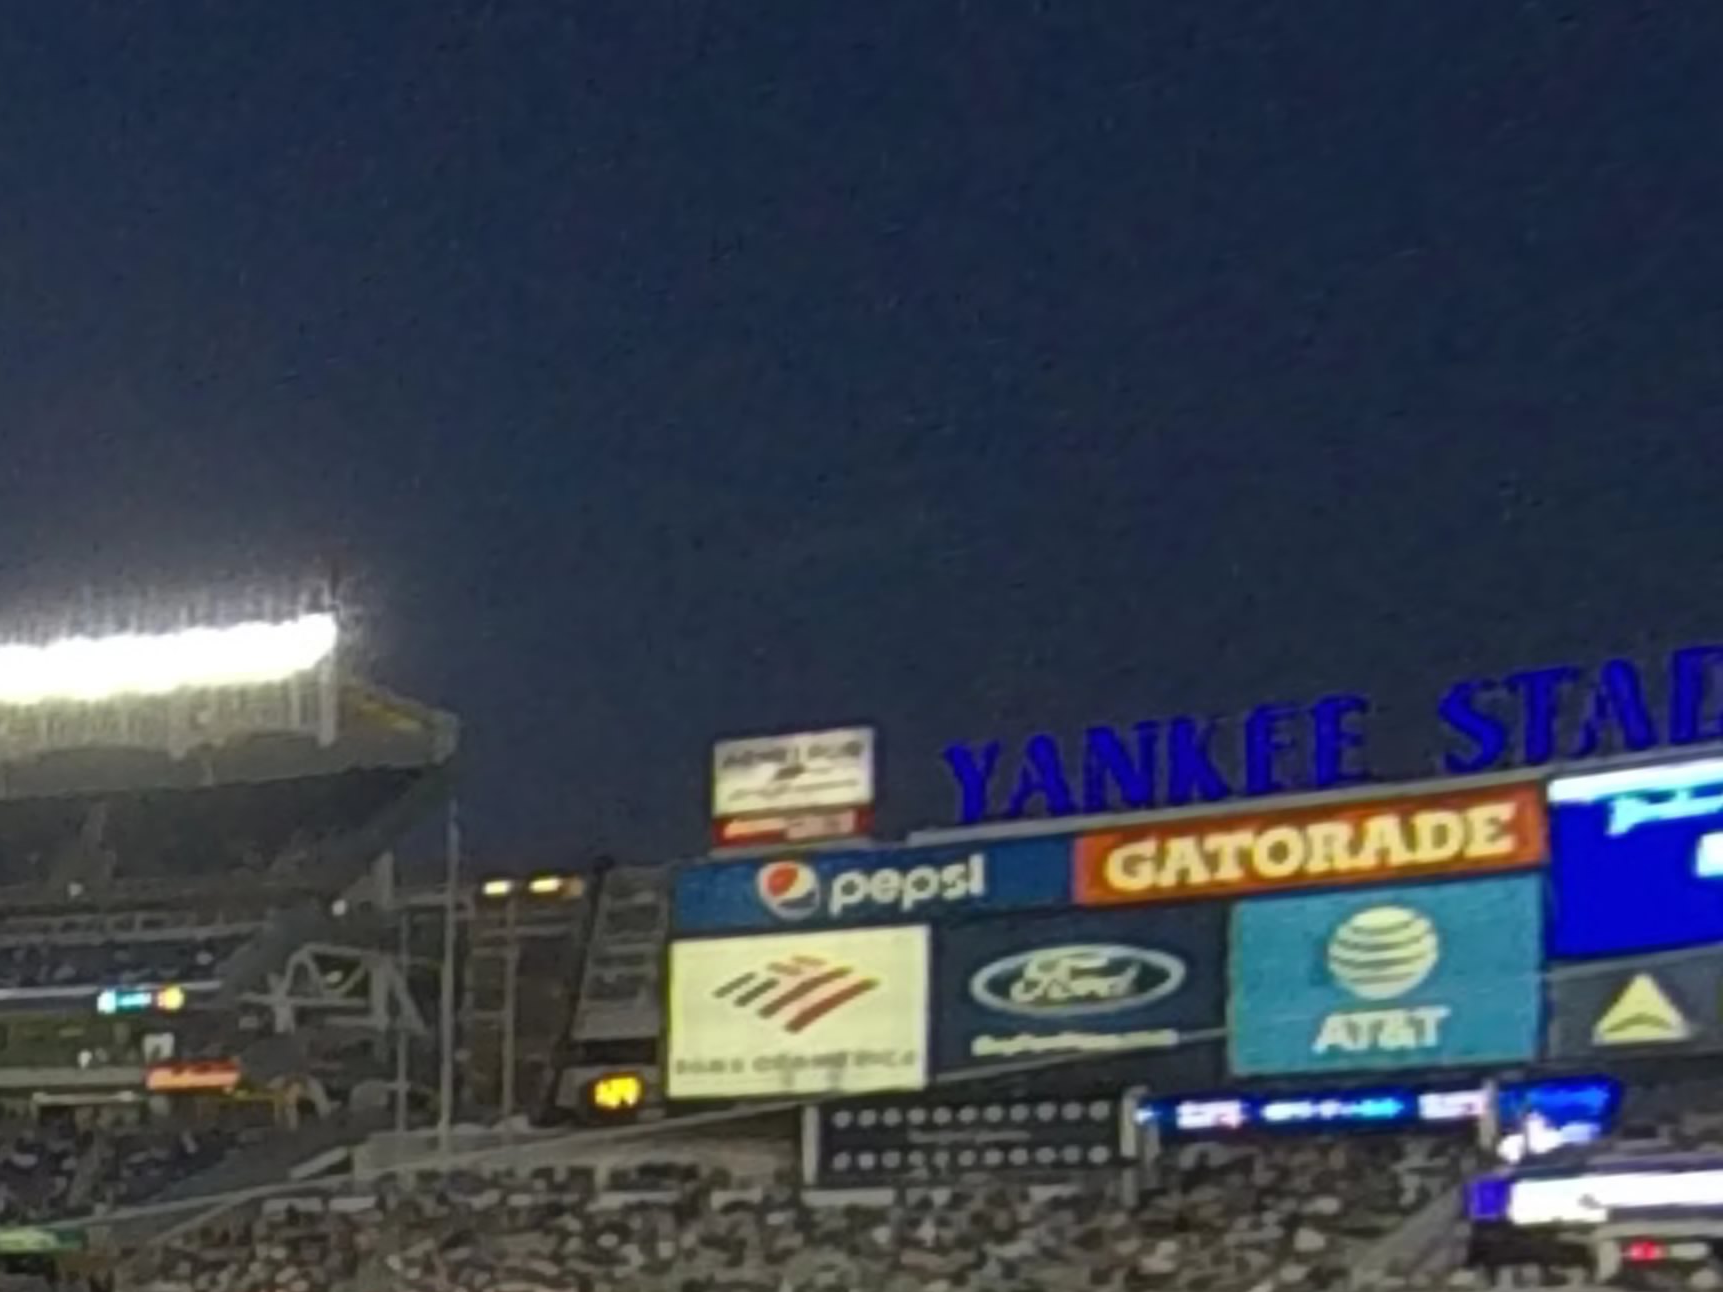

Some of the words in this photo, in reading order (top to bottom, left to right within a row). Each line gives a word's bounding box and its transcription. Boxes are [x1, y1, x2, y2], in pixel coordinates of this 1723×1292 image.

[942, 694, 1367, 824] YANKEE
[828, 854, 986, 917] pepsi
[1104, 803, 1516, 892] GATORADE
[1314, 1005, 1451, 1054] AT&T
